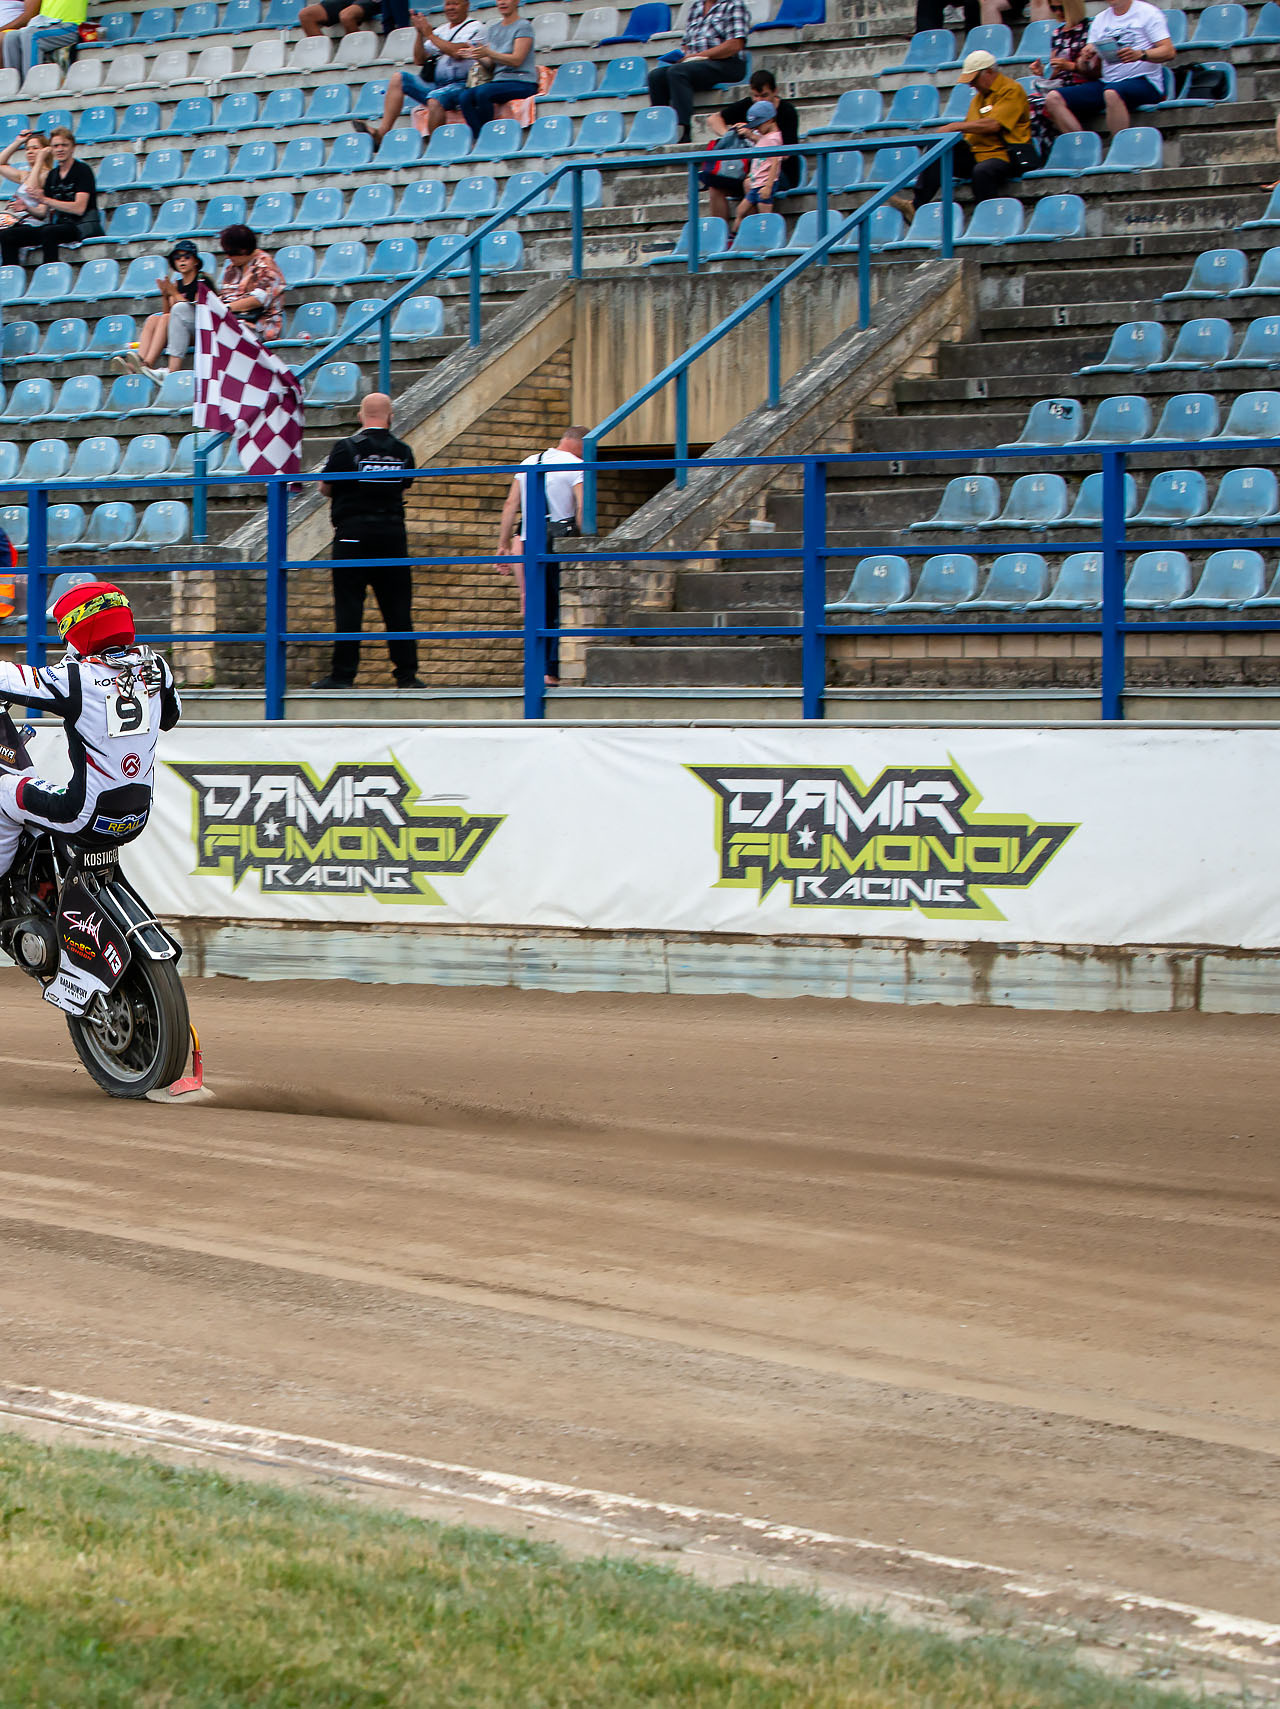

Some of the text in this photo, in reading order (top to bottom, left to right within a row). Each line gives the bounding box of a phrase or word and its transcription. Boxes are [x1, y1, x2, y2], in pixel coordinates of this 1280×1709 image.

[115, 695, 143, 733] 9
[264, 864, 412, 888] RACING
[796, 875, 970, 902] RACING
[103, 943, 123, 975] 113
